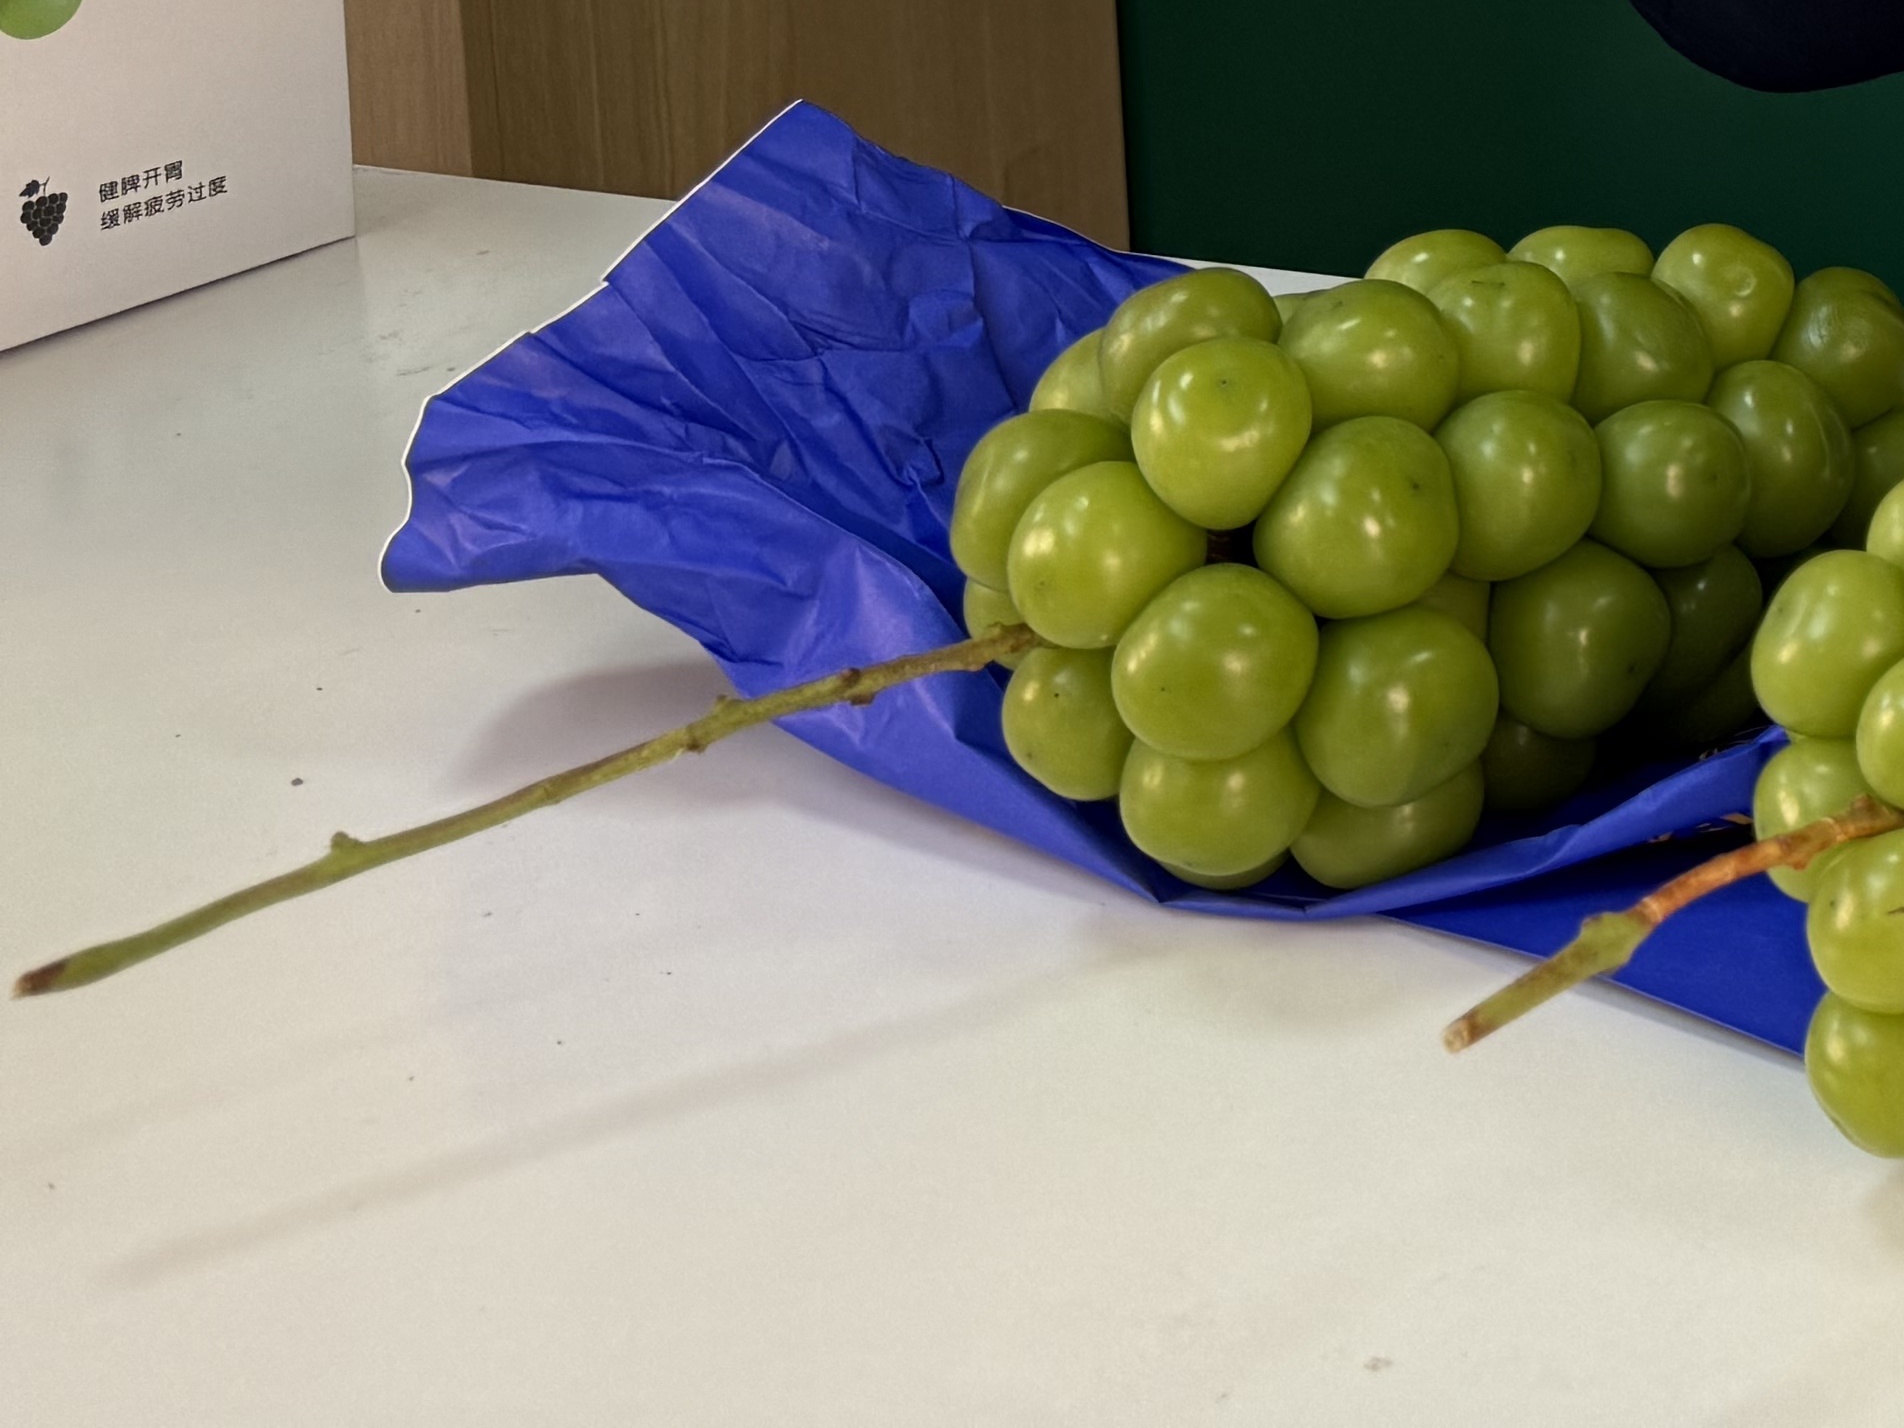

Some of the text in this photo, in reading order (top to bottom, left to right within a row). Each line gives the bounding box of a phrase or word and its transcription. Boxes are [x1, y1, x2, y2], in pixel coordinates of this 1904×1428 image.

[99, 160, 183, 203] 健脾开胃
[100, 176, 228, 230] 缓解疲劳过度
